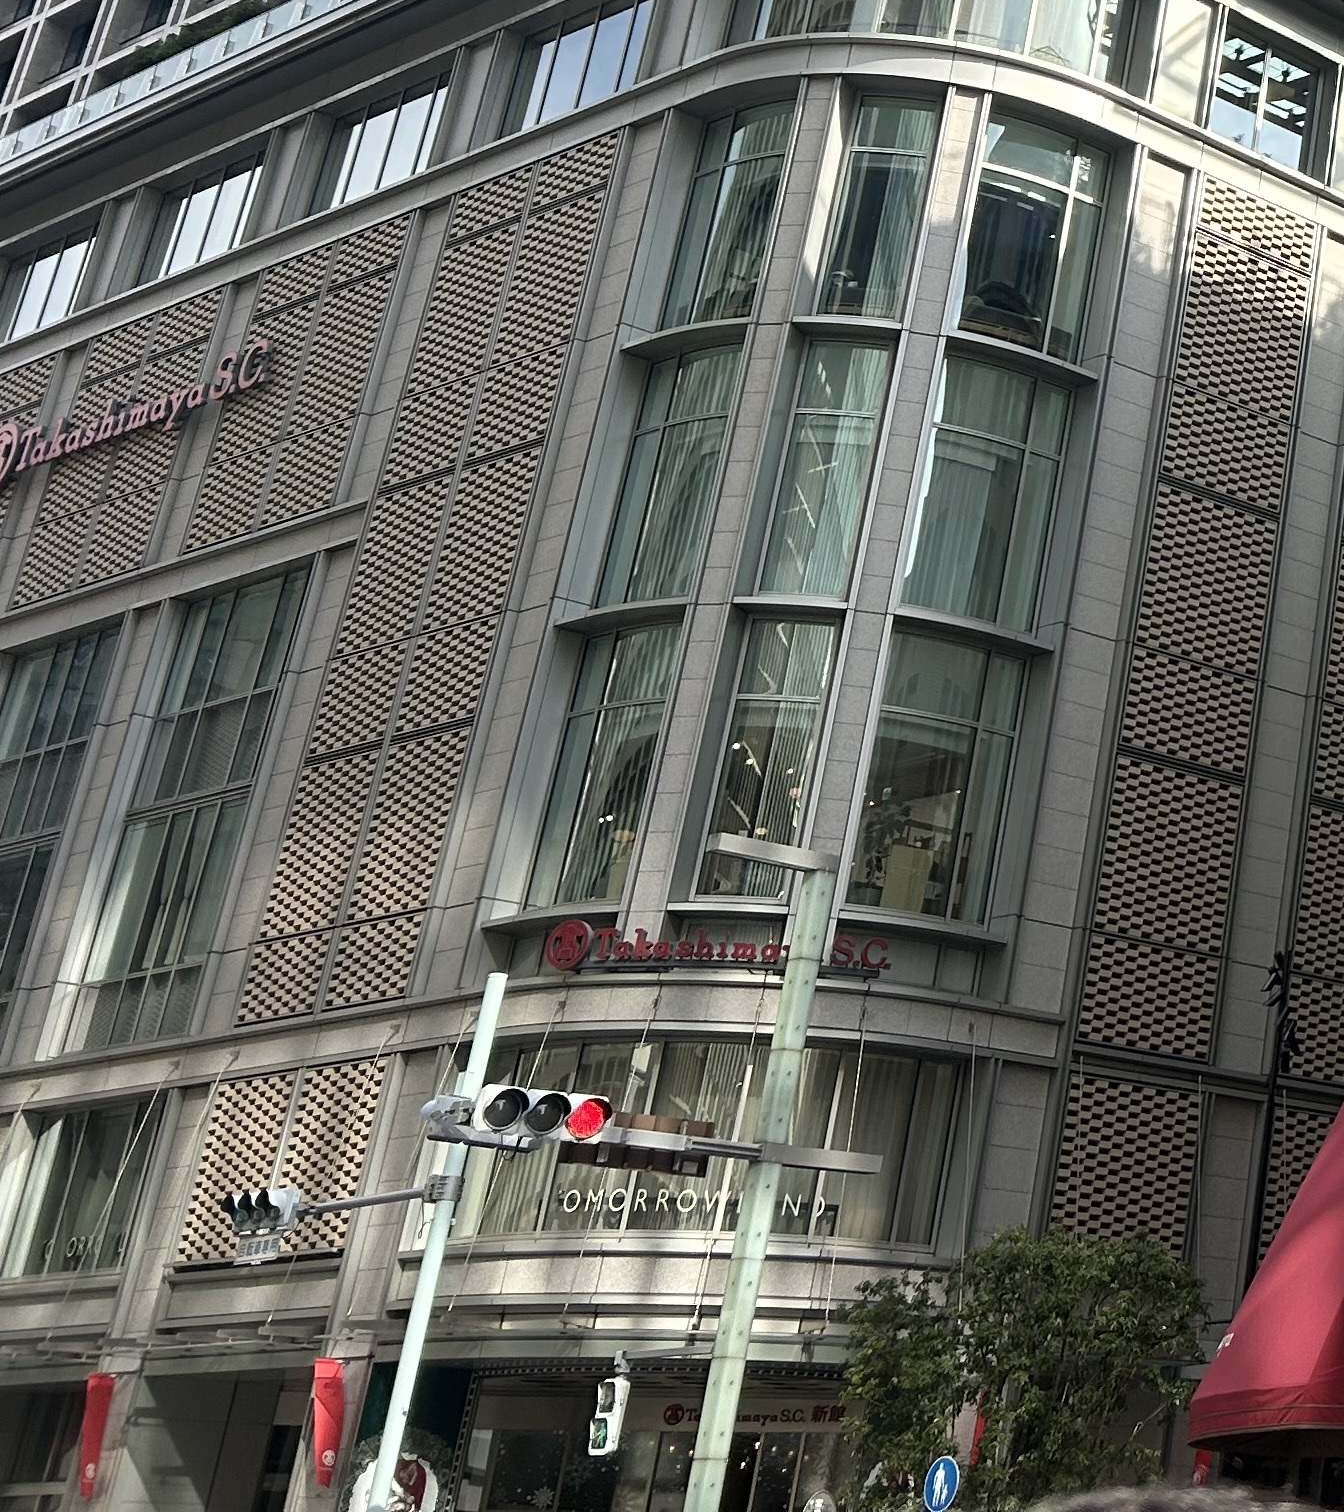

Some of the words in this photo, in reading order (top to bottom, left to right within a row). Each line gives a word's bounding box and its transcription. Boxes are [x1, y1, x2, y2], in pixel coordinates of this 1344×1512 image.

[14, 382, 207, 472] Takashimaya
[594, 927, 794, 962] Takashima
[829, 937, 892, 970] S.C.
[810, 1404, 846, 1424] 新館
